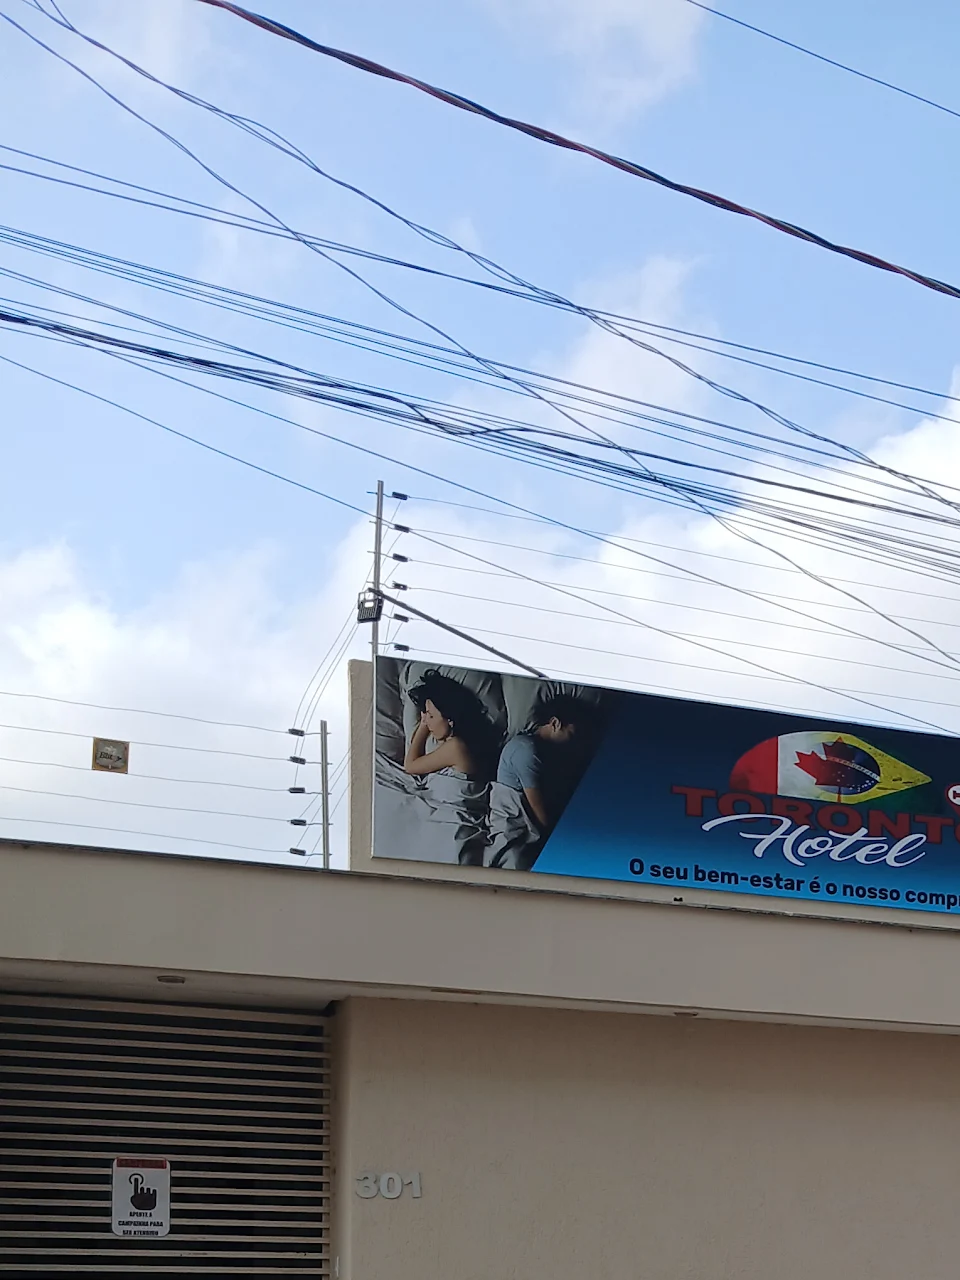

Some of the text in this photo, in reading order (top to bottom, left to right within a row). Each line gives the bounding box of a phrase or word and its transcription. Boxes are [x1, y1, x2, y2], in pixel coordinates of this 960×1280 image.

[701, 813, 927, 868] Hotel
[629, 858, 645, 875] O
[649, 864, 688, 880] seu
[693, 864, 805, 892] bem-estar
[809, 876, 821, 893] é
[825, 882, 838, 895] o
[842, 883, 901, 901] nosso
[355, 1171, 422, 1199] 301
